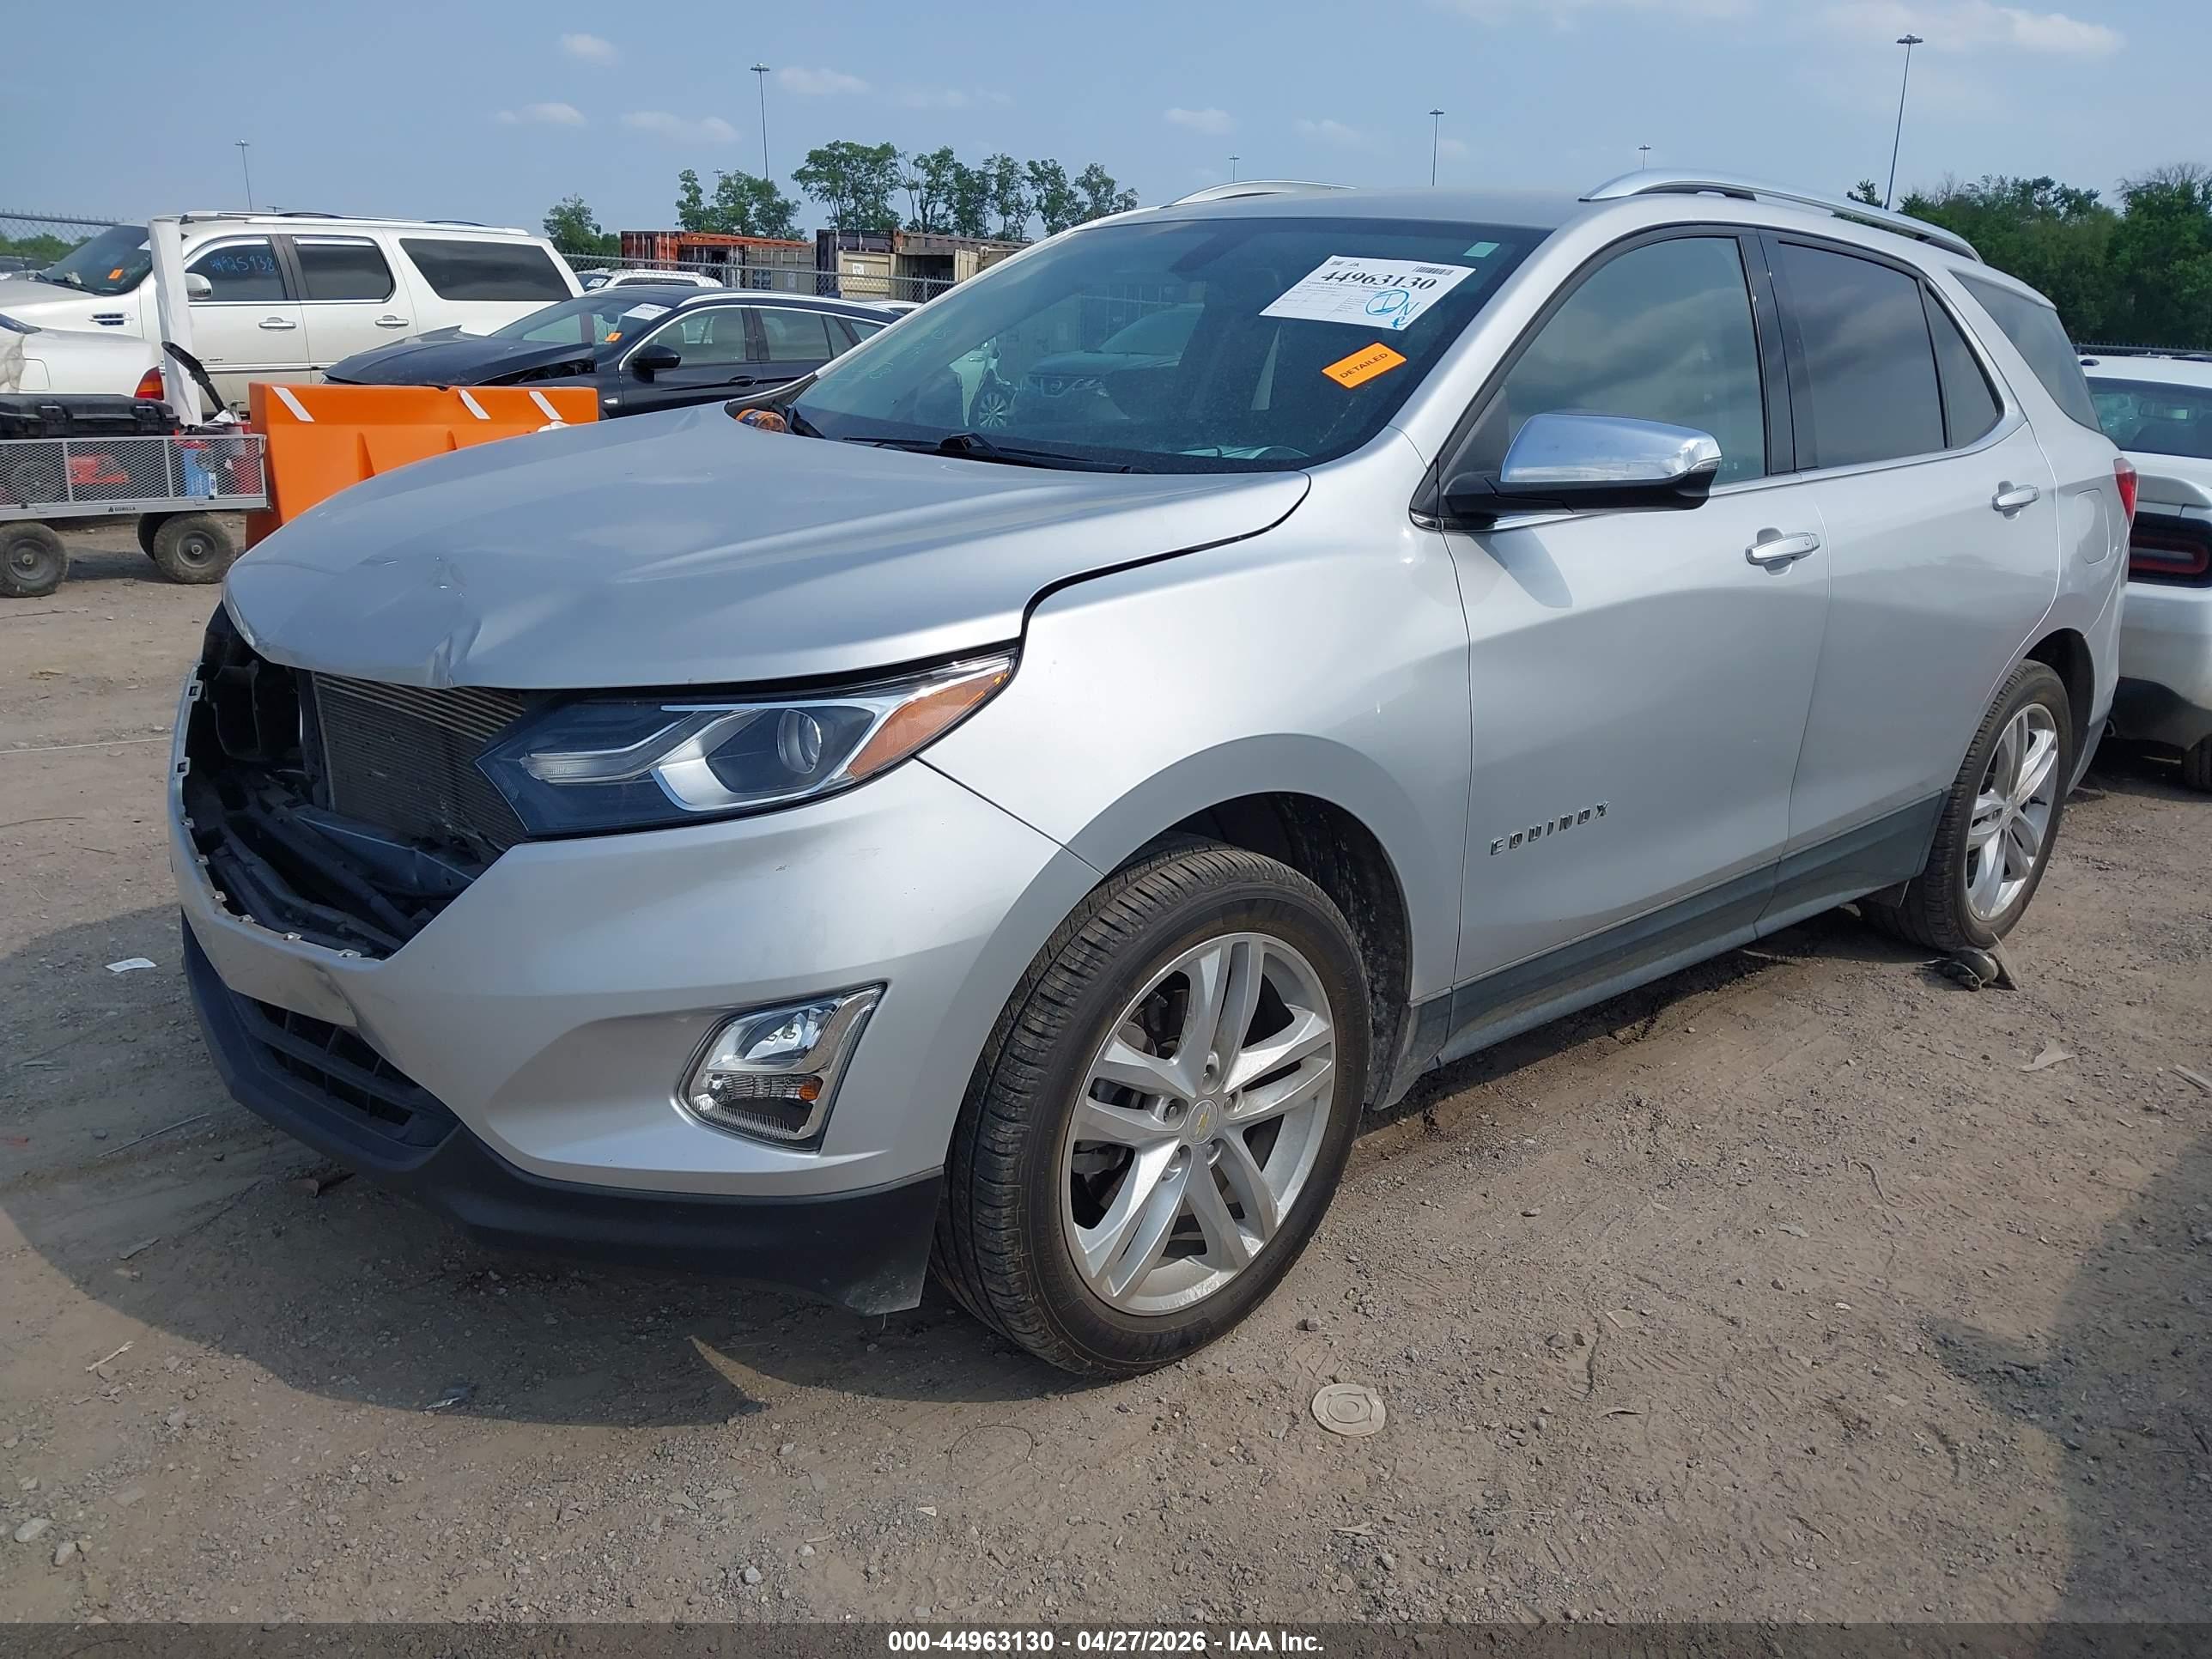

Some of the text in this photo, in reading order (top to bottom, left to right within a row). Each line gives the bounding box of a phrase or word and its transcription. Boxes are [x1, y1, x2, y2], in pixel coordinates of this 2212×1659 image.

[1321, 270, 1438, 290] 44963130
[1339, 352, 1389, 379] DETAILED
[1490, 800, 1610, 856] EQUINOX
